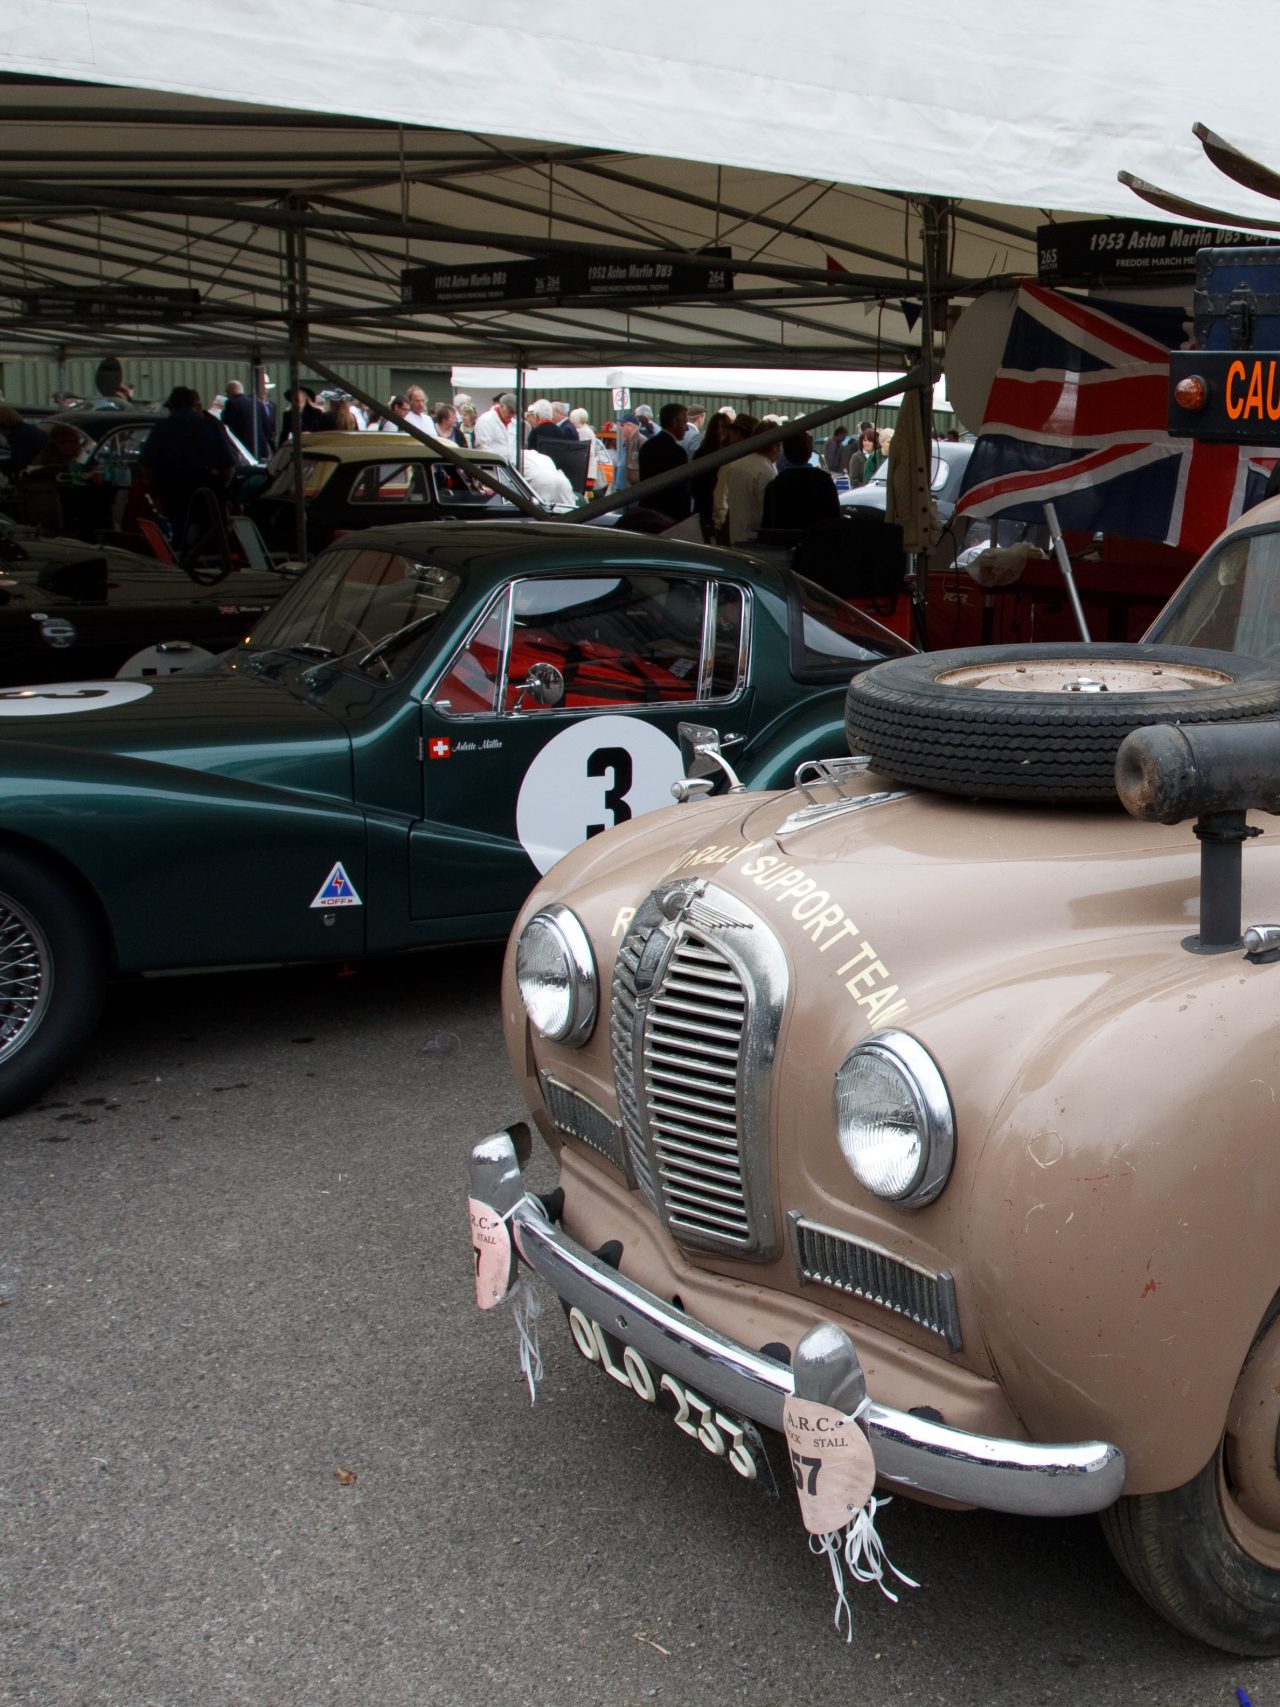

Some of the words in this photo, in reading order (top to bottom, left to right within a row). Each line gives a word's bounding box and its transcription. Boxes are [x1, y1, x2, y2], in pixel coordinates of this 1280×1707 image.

[1090, 232, 1125, 251] 1953
[1128, 230, 1166, 250] Aston
[1170, 228, 1212, 248] Martin
[1041, 249, 1057, 264] 265
[1116, 258, 1150, 267] FREDDIE
[1152, 257, 1181, 266] MARCH
[588, 267, 607, 280] 1952
[607, 265, 627, 279] Aston
[628, 263, 653, 278] Martin
[655, 264, 673, 278] DB3
[709, 271, 724, 283] 264
[586, 747, 633, 839] 3
[741, 855, 860, 953] SUPPORT
[836, 940, 911, 1030] TEAM
[570, 1306, 656, 1403] OLO
[813, 1437, 848, 1448] STALL
[791, 1447, 822, 1496] 57
